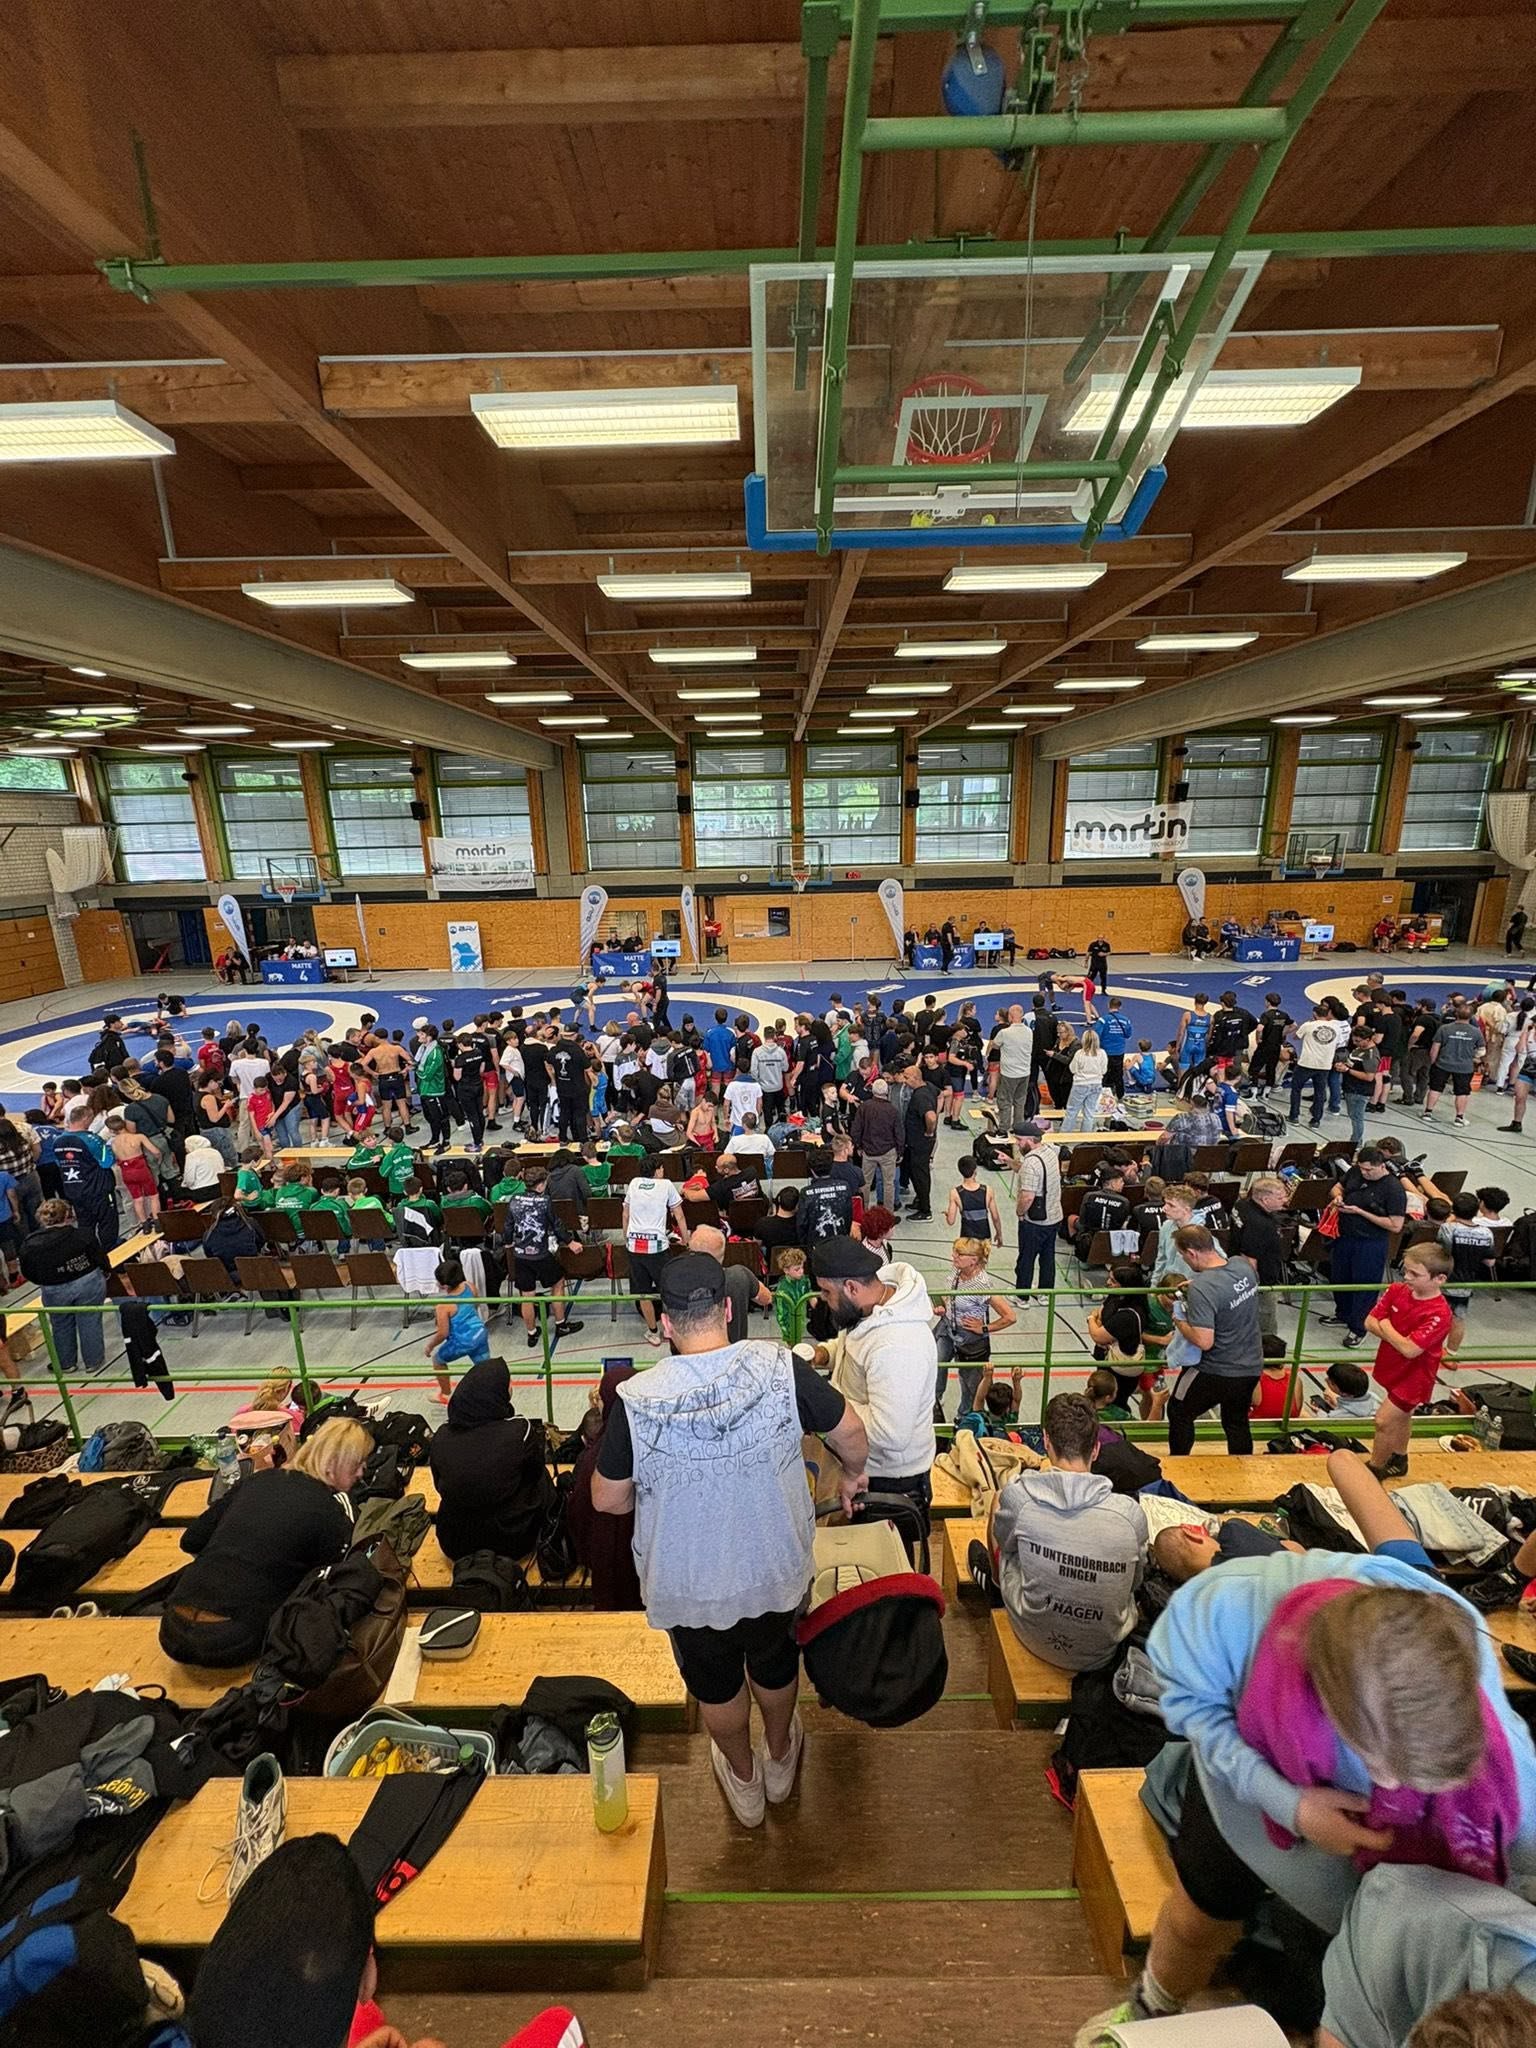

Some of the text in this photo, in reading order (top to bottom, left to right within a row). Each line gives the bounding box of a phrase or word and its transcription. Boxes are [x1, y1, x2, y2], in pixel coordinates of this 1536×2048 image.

[1074, 811, 1188, 842] martin
[456, 844, 506, 856] martin
[1273, 939, 1295, 947] MATTE
[1280, 947, 1287, 960] 1
[954, 955, 962, 967] 2
[631, 962, 639, 975] 3
[299, 970, 309, 982] 4
[1095, 1197, 1122, 1208] ASV HOF
[1233, 1276, 1250, 1294] RSC
[1030, 1542, 1127, 1574] TV UNTERDÜRRBACH
[1058, 1564, 1098, 1583] RINGEN
[1053, 1602, 1104, 1621] HAGEN
